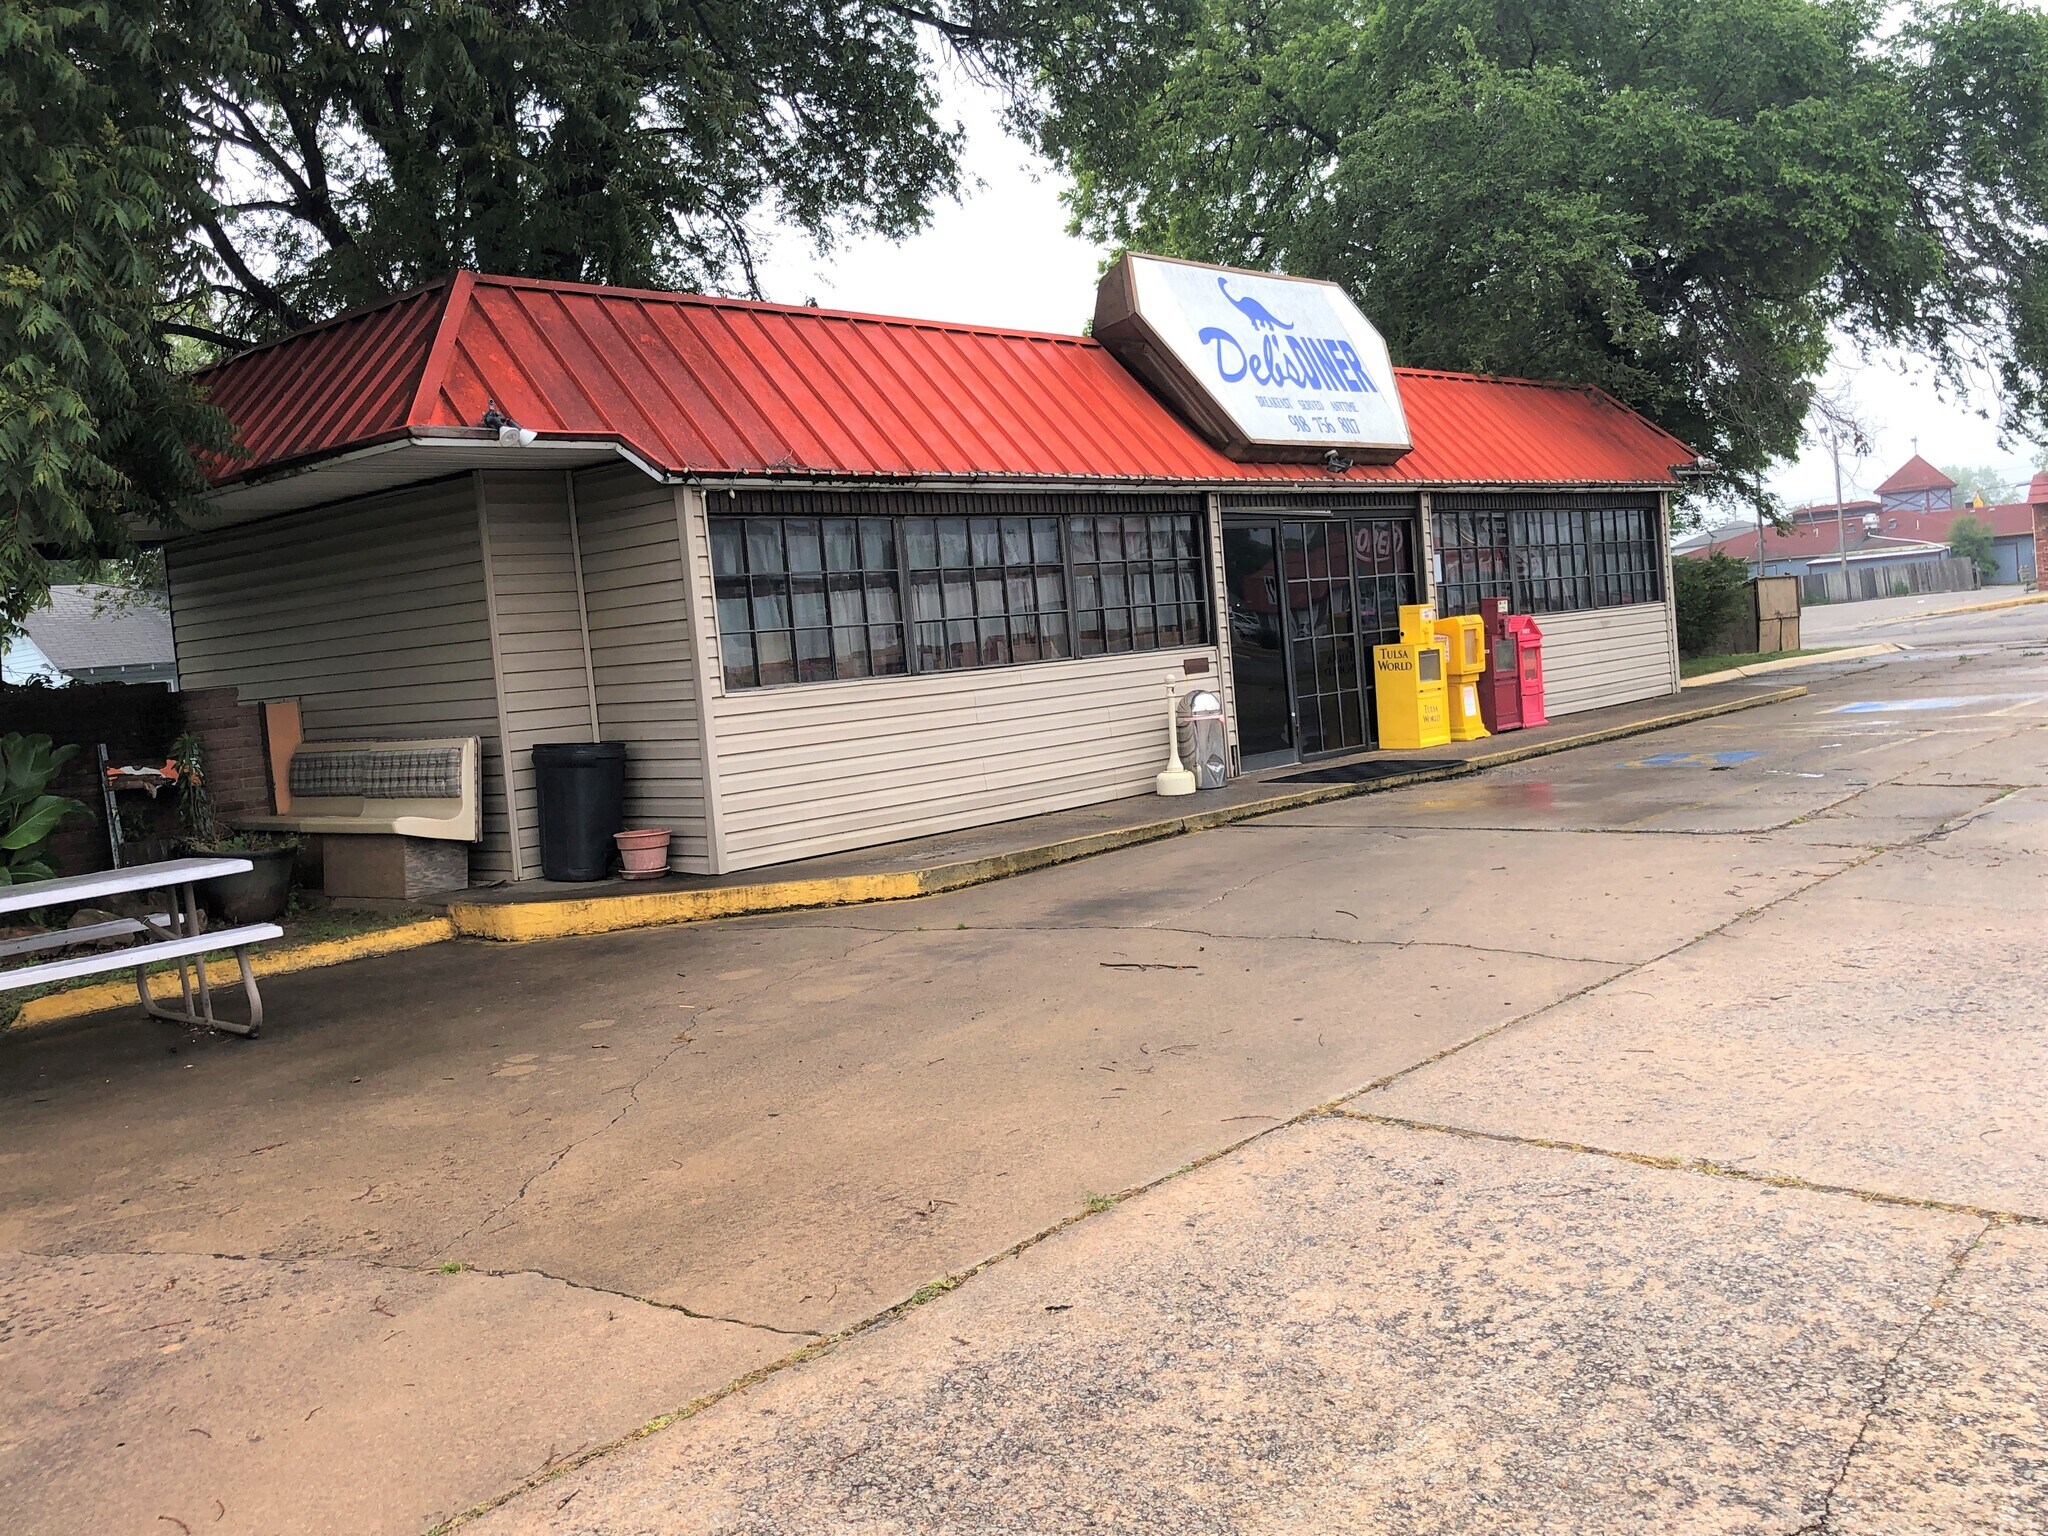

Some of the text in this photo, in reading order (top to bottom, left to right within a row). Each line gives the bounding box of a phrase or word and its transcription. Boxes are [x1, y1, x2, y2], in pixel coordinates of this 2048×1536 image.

[1198, 327, 1379, 393] Deb's DINER
[1255, 395, 1360, 413] BREAKFAST SERVED ANYTIME
[1287, 414, 1361, 435] 918 756 8117
[1380, 648, 1409, 660] TULSA
[1377, 660, 1413, 672] WORLD
[1423, 704, 1439, 714] TULSA
[1422, 714, 1441, 723] WORLD
